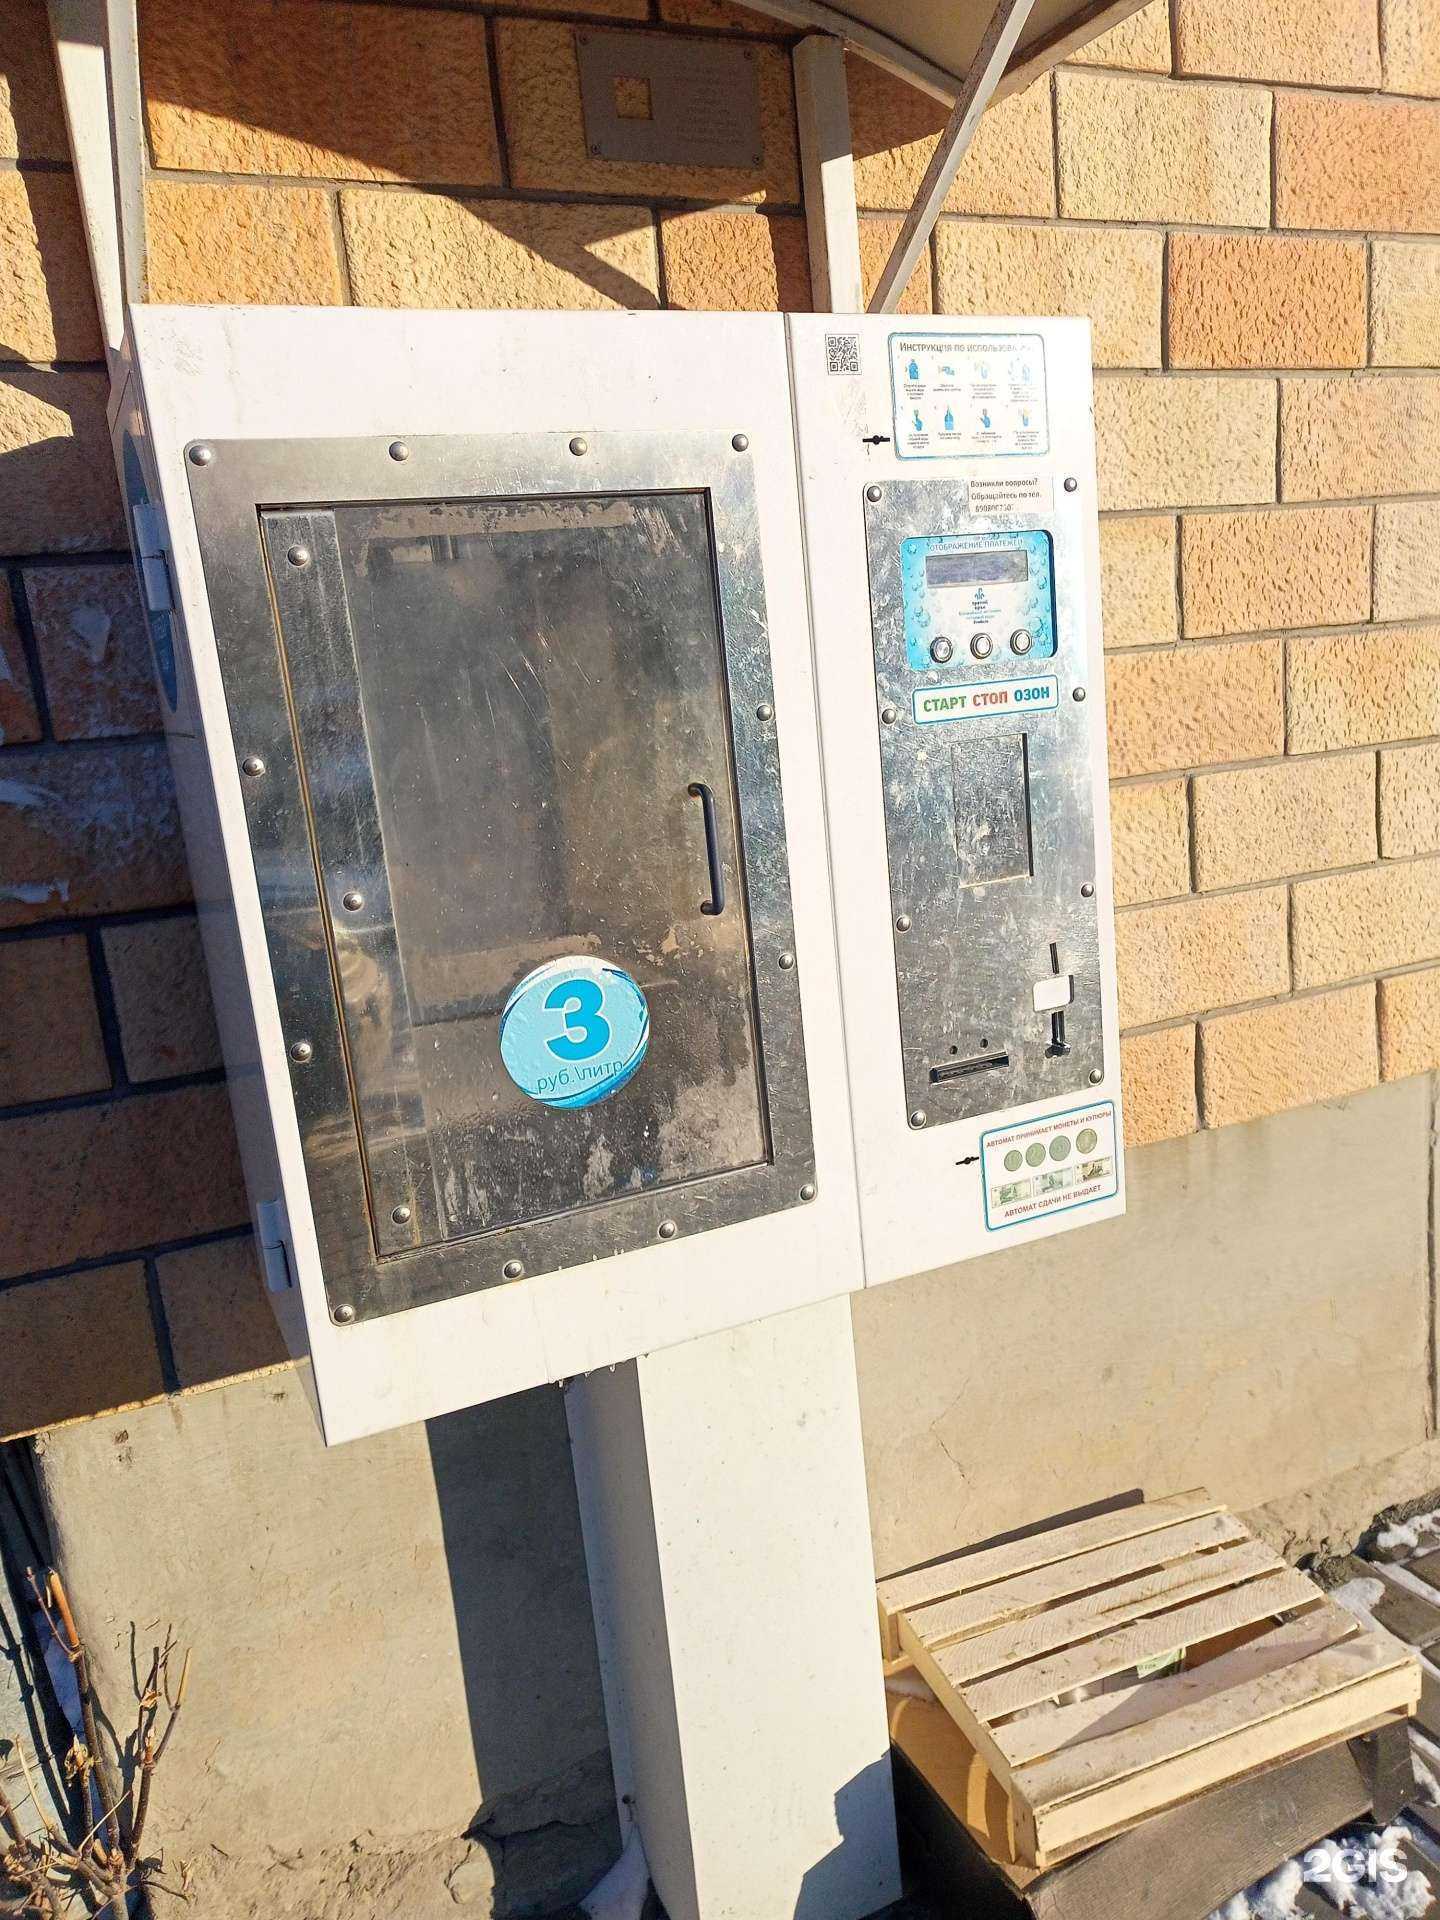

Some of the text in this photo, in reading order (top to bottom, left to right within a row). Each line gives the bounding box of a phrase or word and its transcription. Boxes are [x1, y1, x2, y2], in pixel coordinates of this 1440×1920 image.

[970, 477, 1038, 488] Возникли вопросы?
[971, 491, 1018, 501] Обращайтесь
[929, 541, 983, 552] ОТОБРАЖЕНИЕ
[923, 686, 1050, 713] СТАРТ СТОП ОЗОН
[544, 978, 611, 1062] 3
[986, 1135, 1015, 1148] АВТОМАТ
[1016, 1126, 1052, 1140] ПРИНИМАЕТ
[1053, 1119, 1080, 1131] МОНЕТЫ
[1085, 1111, 1112, 1123] КУПЮРЫ
[1004, 1184, 1102, 1218] АВТОМАТ СДАЧИ НЕ ВЫДАЕТ
